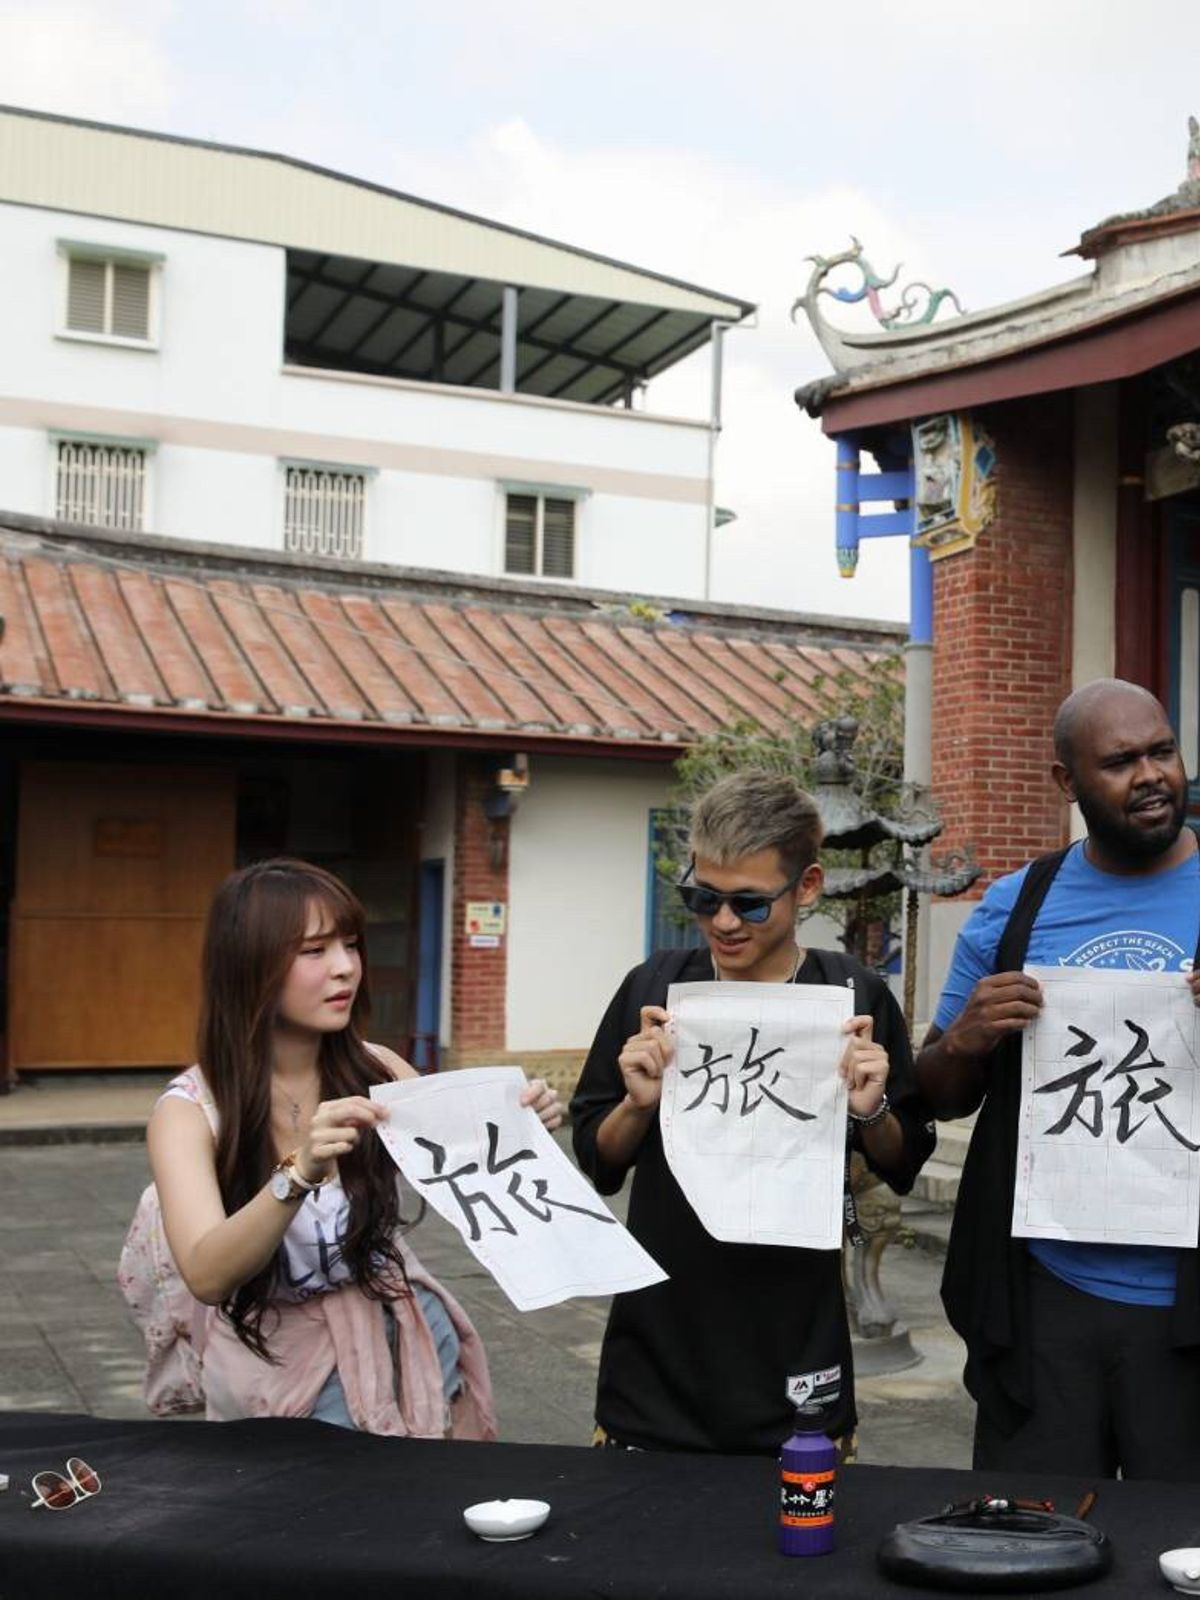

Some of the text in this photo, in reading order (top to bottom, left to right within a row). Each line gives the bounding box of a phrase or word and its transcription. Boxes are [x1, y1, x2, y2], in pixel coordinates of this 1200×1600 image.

[1075, 937, 1175, 964] RESPECT THE BEACH
[681, 1027, 817, 1121] 旅
[414, 1122, 616, 1242] 旅
